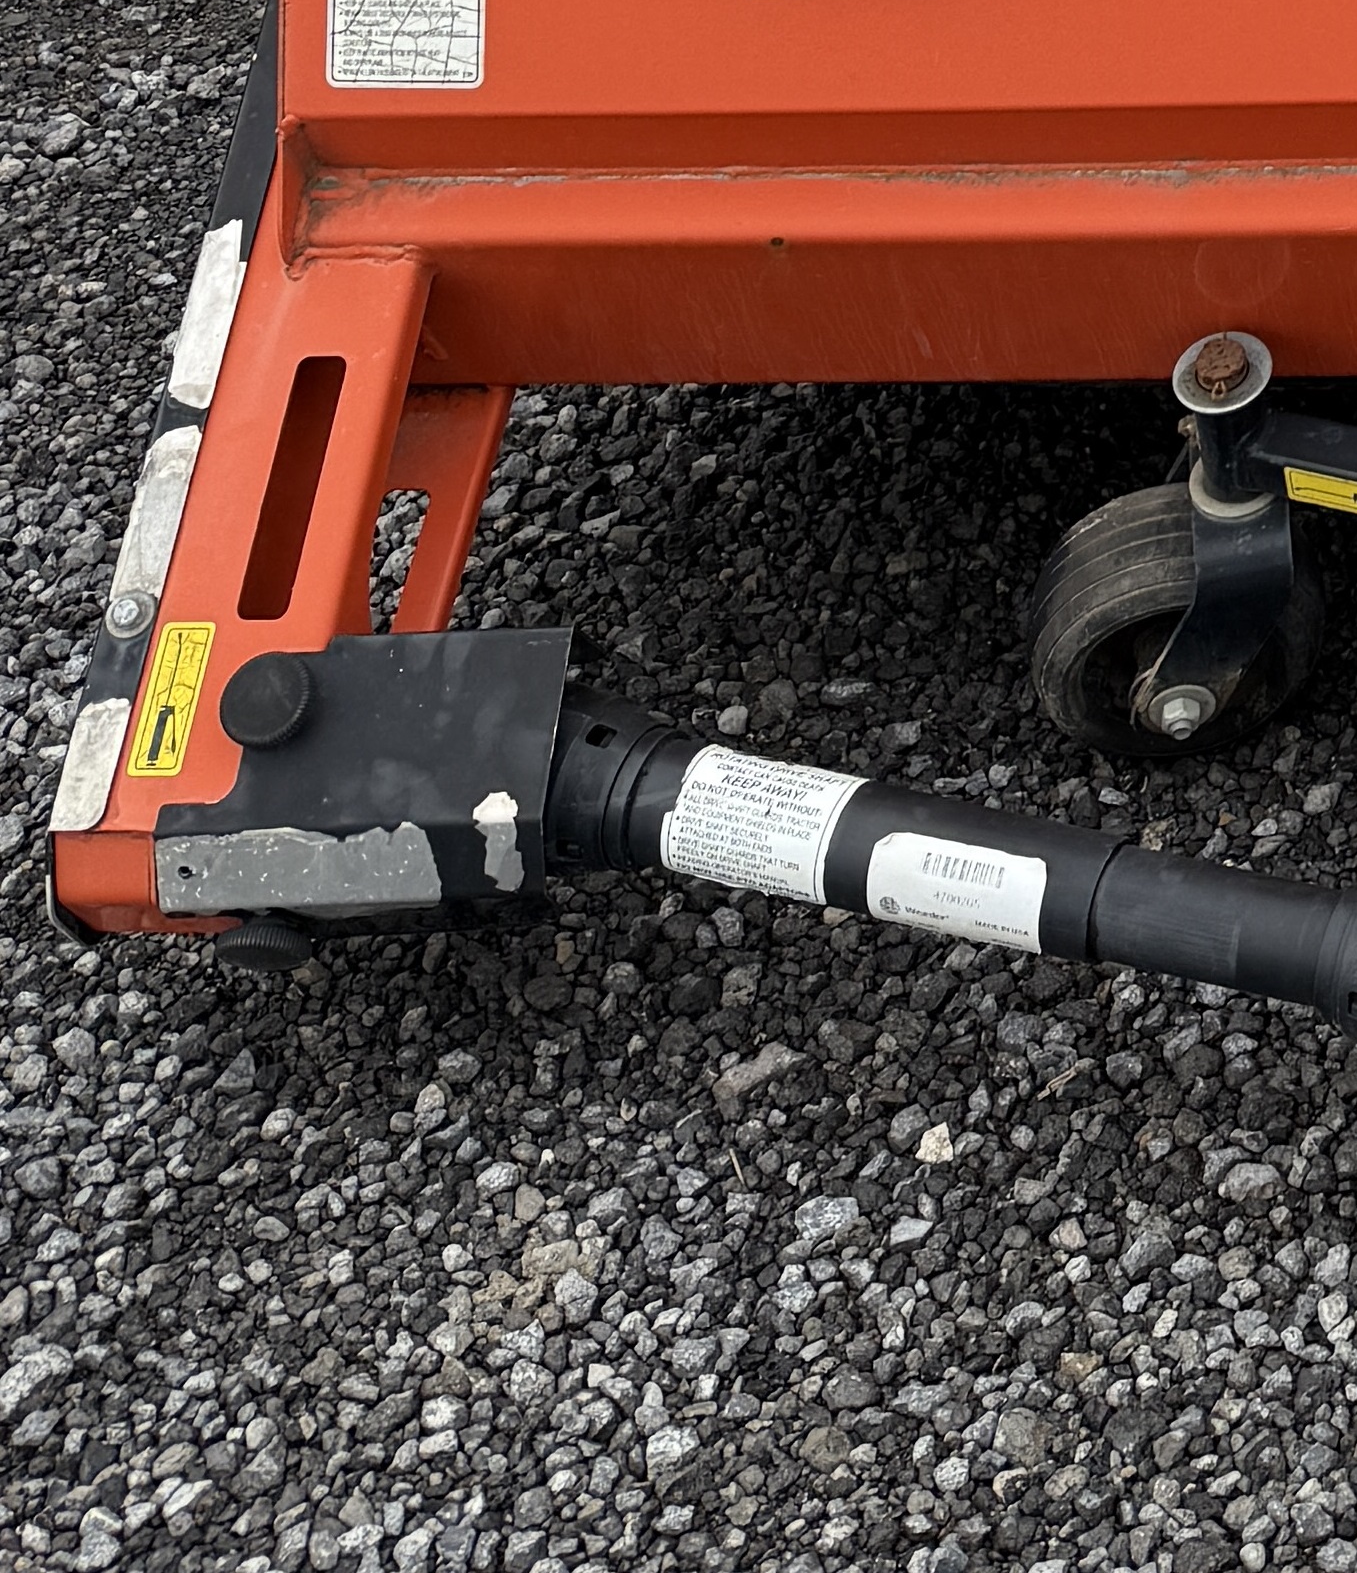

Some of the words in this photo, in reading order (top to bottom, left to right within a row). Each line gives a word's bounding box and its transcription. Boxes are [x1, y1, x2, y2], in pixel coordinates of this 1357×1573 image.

[692, 781, 706, 791] DO
[707, 784, 727, 796] NOT
[721, 774, 762, 790] KEEP
